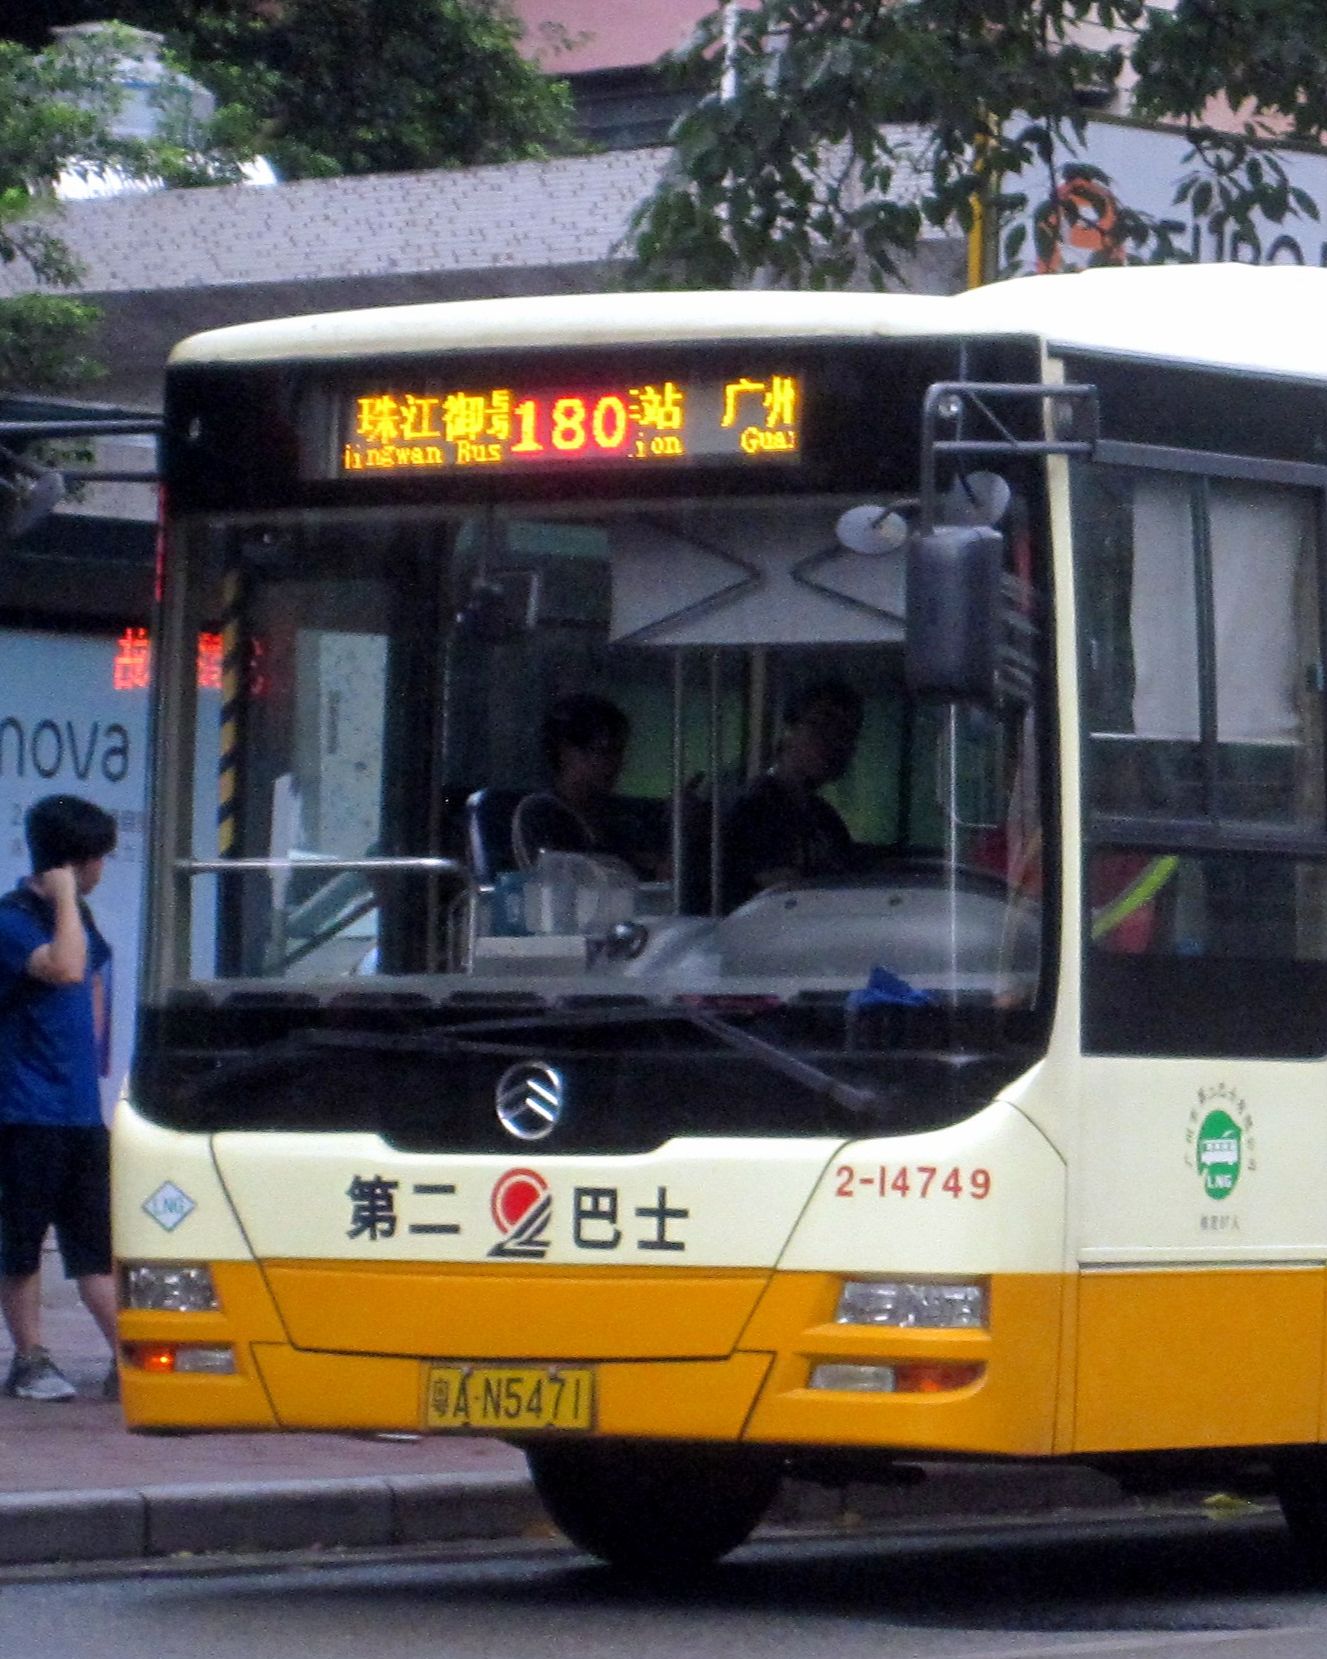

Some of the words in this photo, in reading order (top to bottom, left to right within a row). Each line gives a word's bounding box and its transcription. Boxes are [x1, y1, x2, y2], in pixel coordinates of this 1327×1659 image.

[511, 395, 627, 454] 180
[628, 381, 684, 430] 站
[720, 374, 796, 429] 广州
[835, 1166, 991, 1200] 2-14749
[346, 1175, 461, 1242] 第二
[573, 1186, 690, 1252] 巴士
